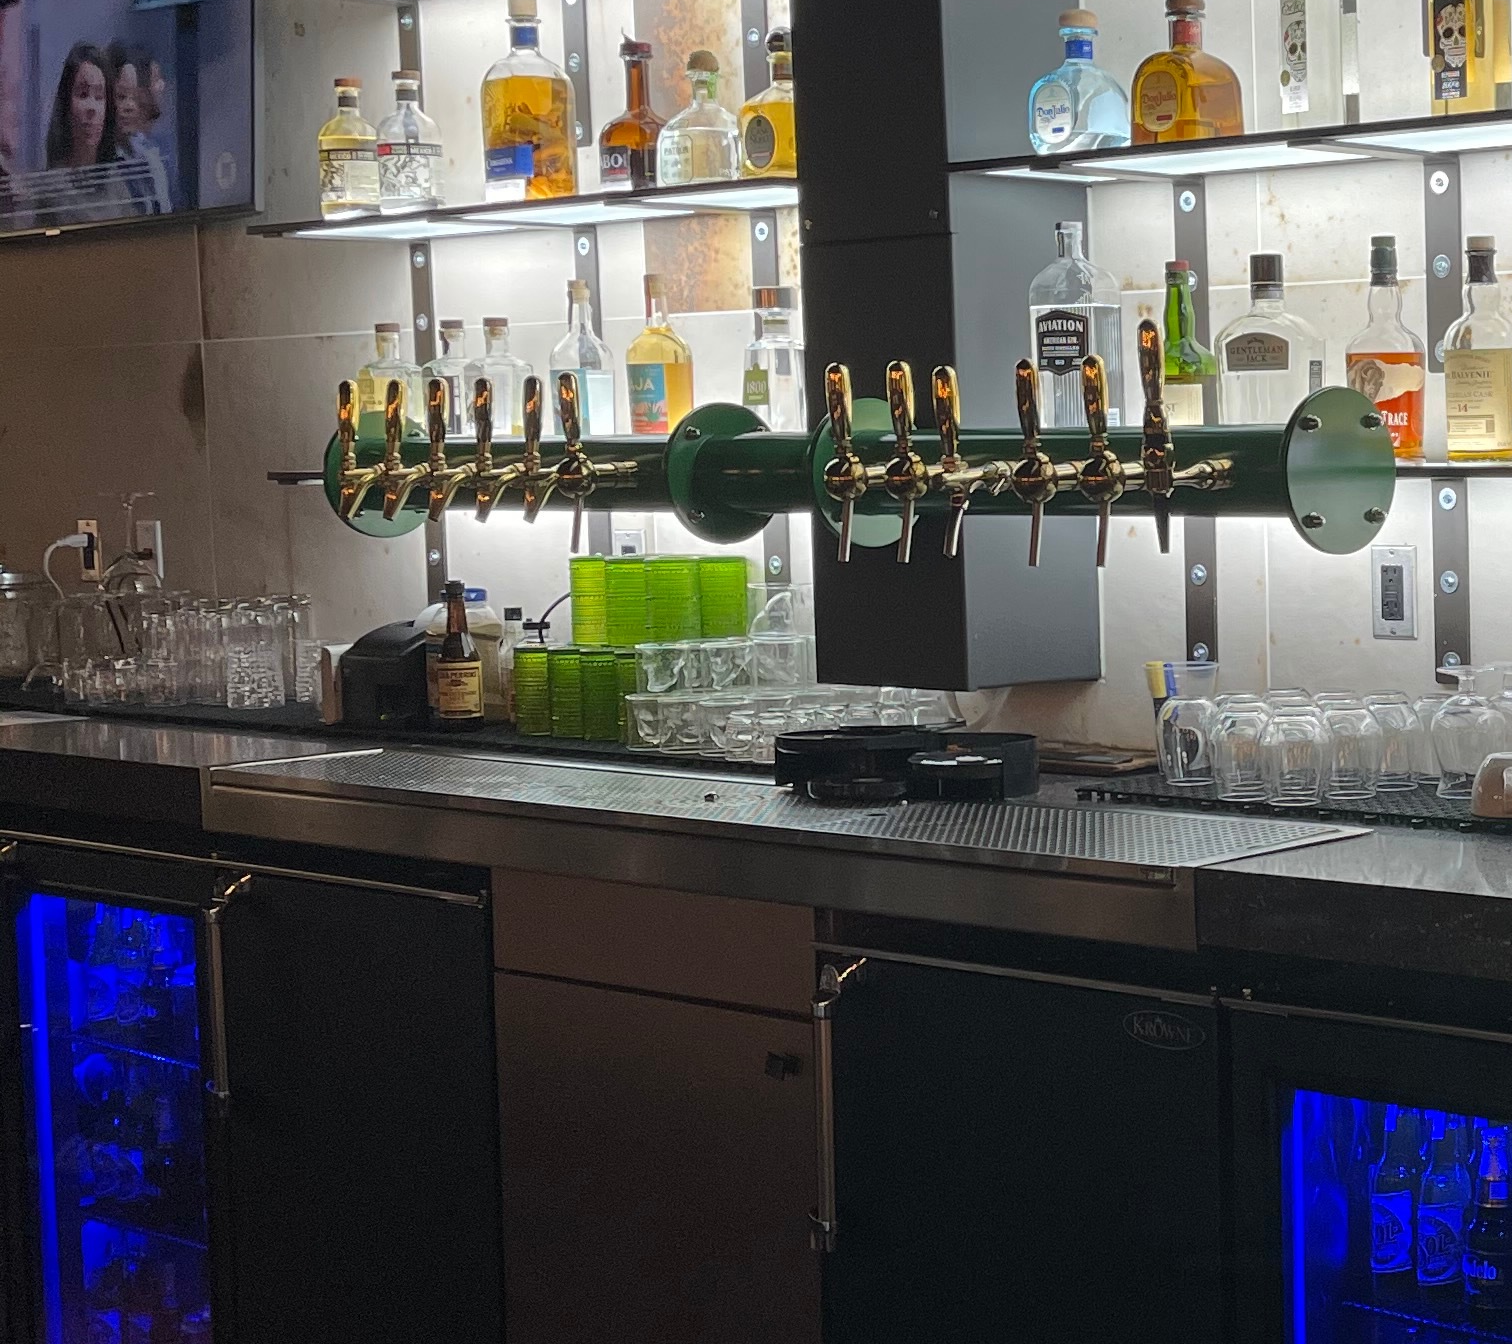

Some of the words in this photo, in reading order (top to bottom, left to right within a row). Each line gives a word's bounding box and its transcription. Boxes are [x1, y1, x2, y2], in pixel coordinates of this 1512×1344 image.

[1038, 319, 1084, 333] AVIATION
[1230, 345, 1283, 355] GENTLEMAN
[1245, 354, 1268, 363] JACK
[746, 380, 767, 394] 1800
[1457, 403, 1468, 413] 14
[1380, 410, 1409, 426] TRACE
